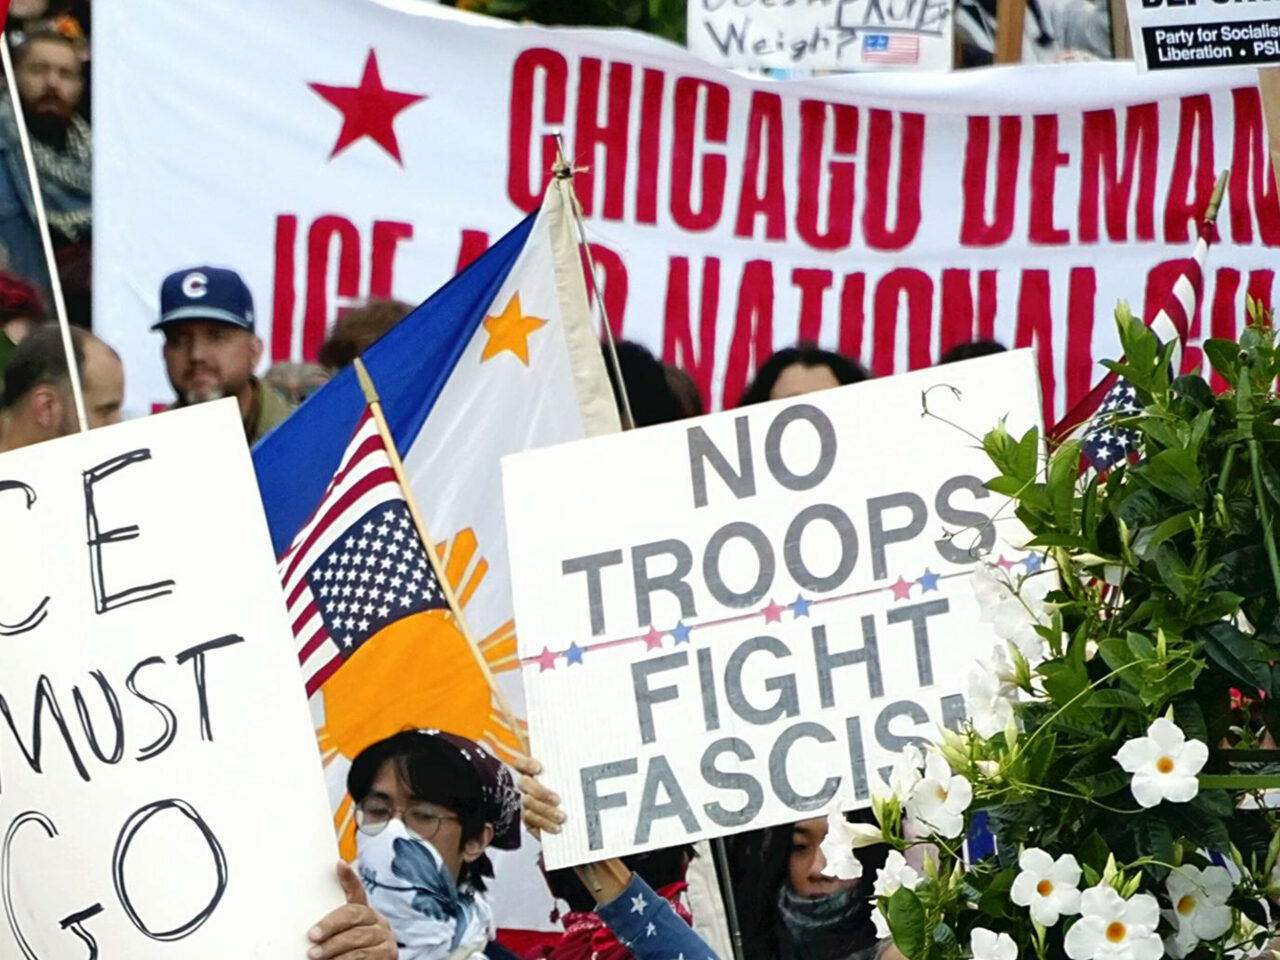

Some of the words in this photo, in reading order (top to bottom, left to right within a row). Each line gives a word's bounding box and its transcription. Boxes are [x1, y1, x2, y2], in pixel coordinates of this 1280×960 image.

[1155, 29, 1194, 47] Party
[1197, 27, 1218, 42] for
[1220, 23, 1280, 41] Socialis
[1158, 44, 1232, 61] Liberation
[507, 48, 924, 252] CHICAGO
[182, 272, 208, 298] C
[687, 403, 838, 509] NO
[561, 475, 997, 637] TROOPS
[631, 597, 950, 745] FIGHT
[579, 694, 968, 852] FASCIS
